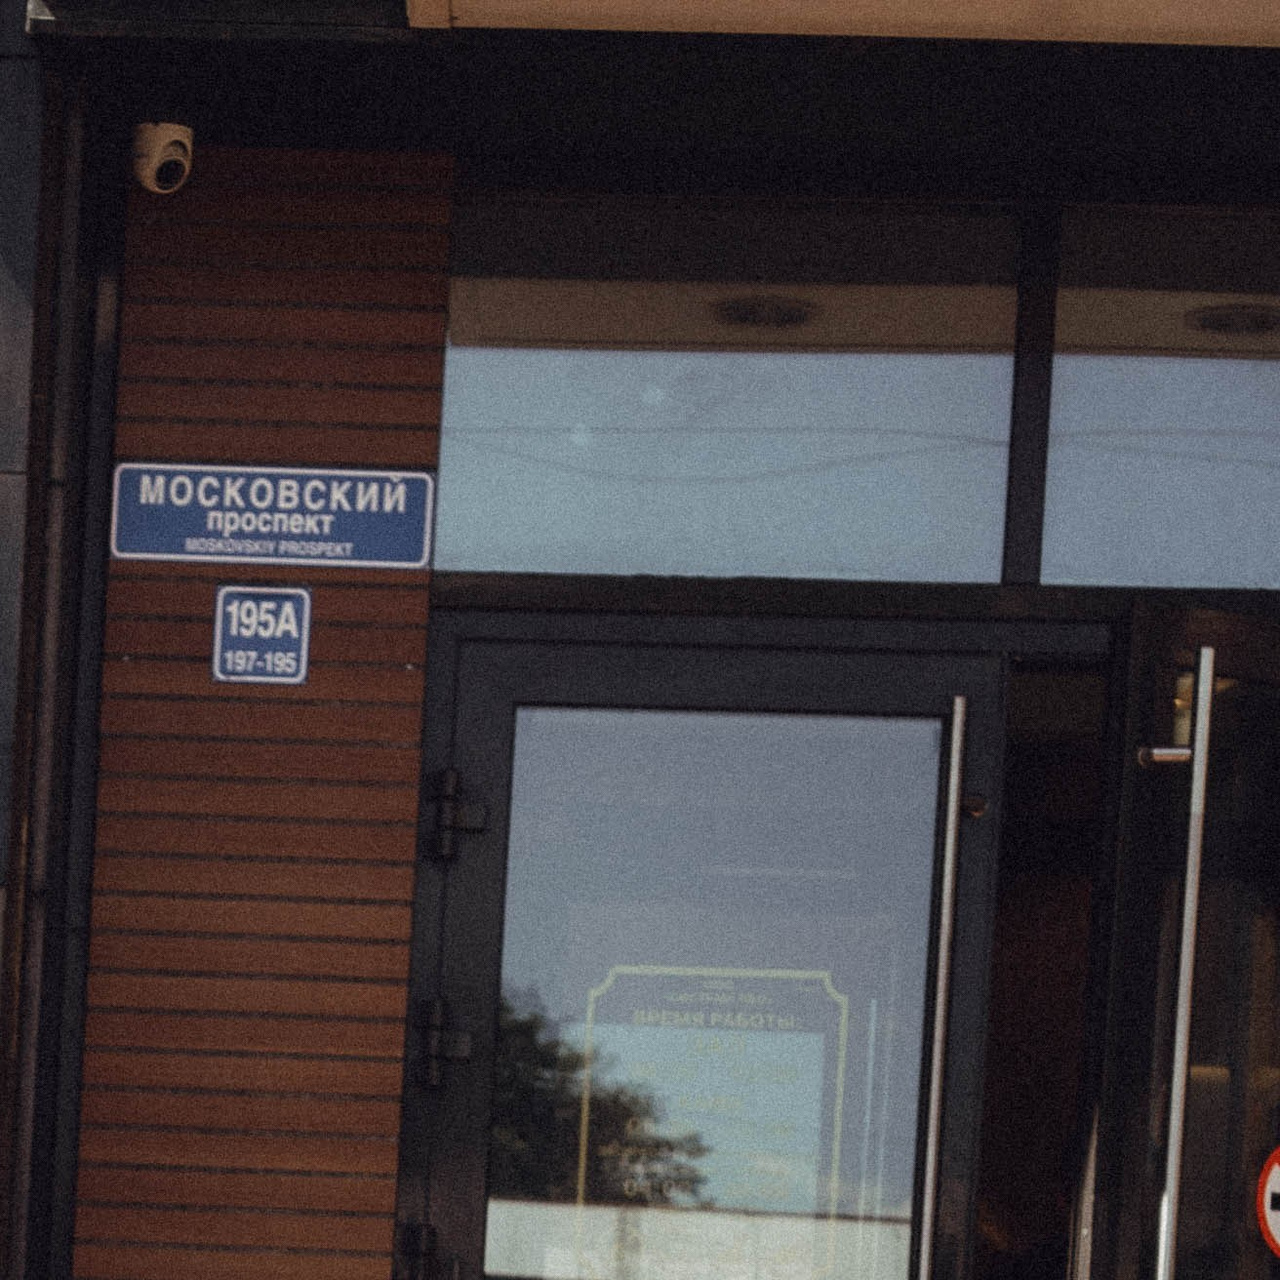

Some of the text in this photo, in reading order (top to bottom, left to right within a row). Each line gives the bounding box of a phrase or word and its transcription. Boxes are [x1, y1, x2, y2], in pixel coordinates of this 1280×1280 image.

[139, 474, 408, 513] МОСКОВСКИЙ
[207, 510, 335, 537] проспект
[278, 540, 354, 557] PROSPEKT
[222, 650, 297, 675] 197-195
